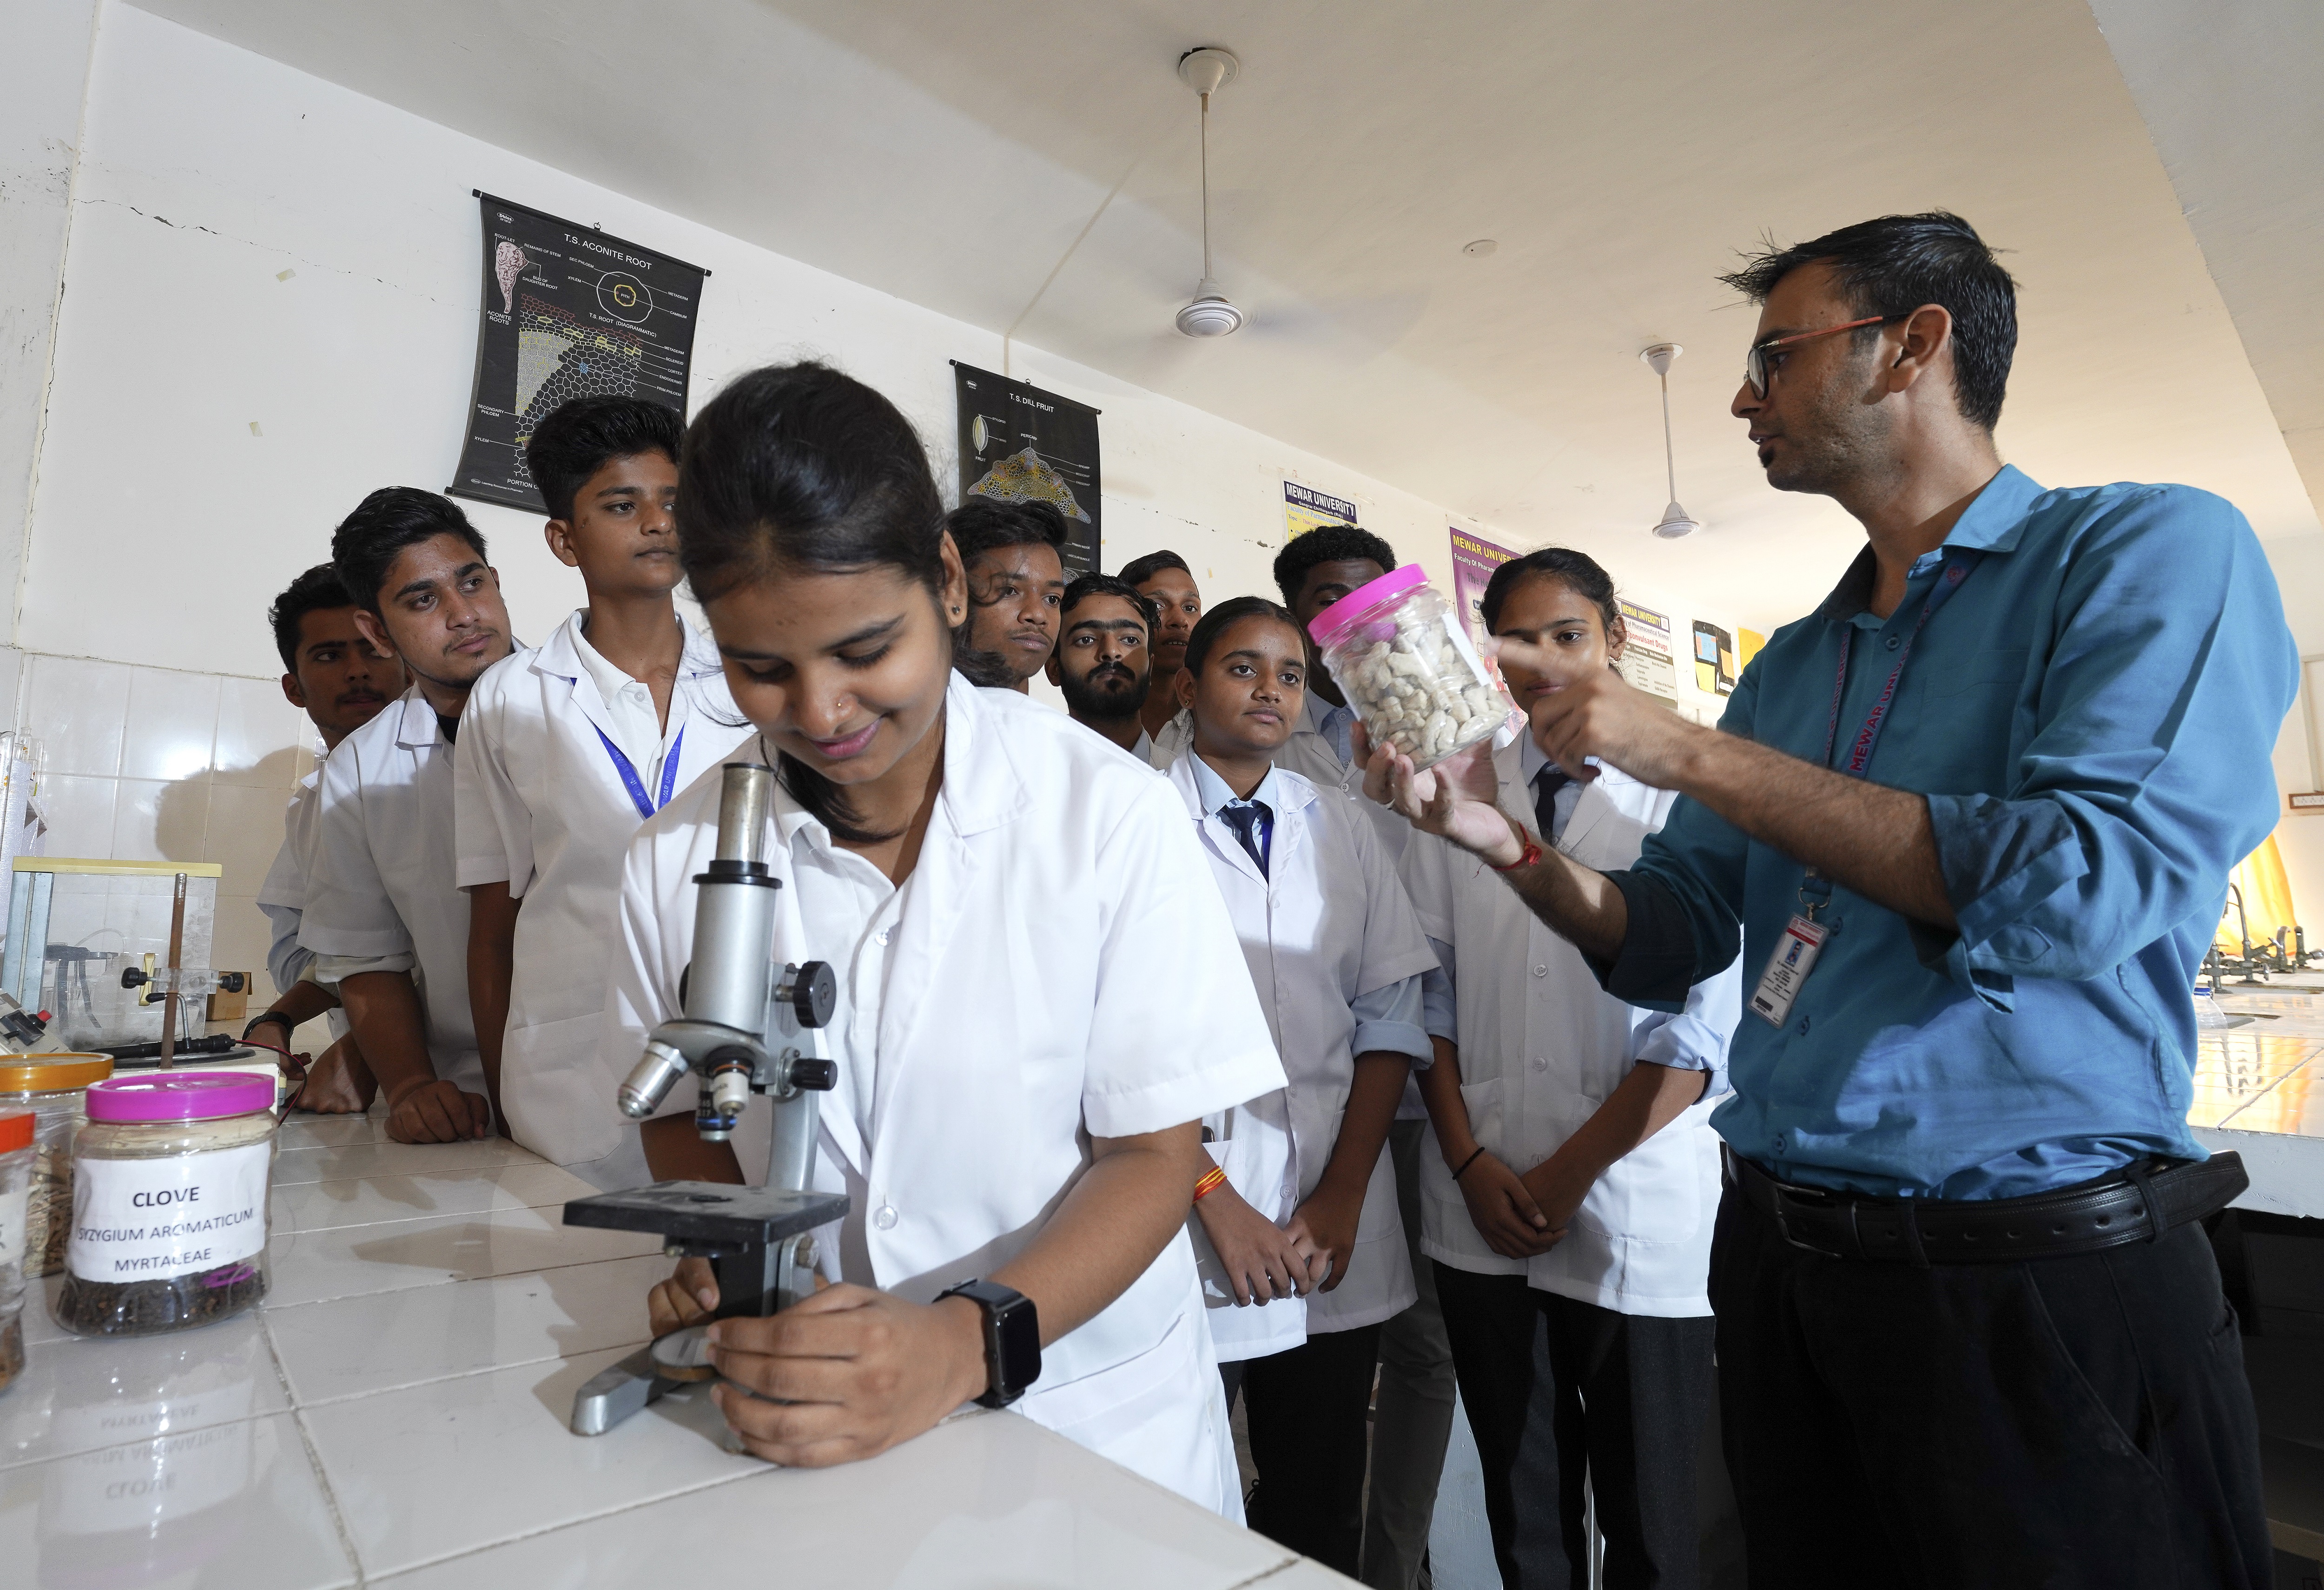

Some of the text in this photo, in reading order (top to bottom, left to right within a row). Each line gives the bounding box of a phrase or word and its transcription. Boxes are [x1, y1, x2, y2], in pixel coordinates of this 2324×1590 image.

[495, 233, 515, 243] ROOT-LET
[524, 243, 543, 252] REMAINS
[564, 233, 652, 270] T.S. ACONITE ROOT
[522, 277, 545, 287] DAUGHTER
[668, 291, 688, 301] METADERM
[487, 310, 511, 321] ACONITE
[489, 316, 509, 325] ROOTS
[616, 320, 656, 337] (DIAGRAMMATIC)
[664, 346, 684, 355] METADERM
[666, 357, 684, 365] SCLEREID
[659, 375, 682, 385] ENDODERMS
[477, 403, 504, 414] SECONDARY
[1023, 397, 1035, 407] DILL
[1037, 402, 1054, 412] FRUIT
[507, 479, 533, 488] PORTION
[1286, 483, 1353, 516] MEWAR UNIVERSITY
[1287, 503, 1303, 515] Faculty
[1310, 511, 1340, 525] Parmaceutical
[1314, 506, 1333, 515] Chittorgarh
[1452, 534, 1482, 555] MEWAR
[1454, 553, 1471, 566] Faculty
[1467, 573, 1479, 585] The
[1622, 603, 1661, 627] MEWAR UNIVERSITY
[1632, 622, 1657, 637] Pharamaceutical
[1658, 631, 1669, 640] Science
[1656, 640, 1668, 652] Drugs
[1849, 706, 1886, 772] MEWAR
[133, 1187, 199, 1207] CLOVE
[78, 1208, 254, 1241] SYZYGIUM AROMATICUM
[114, 1247, 212, 1272] MYRTACEAE
